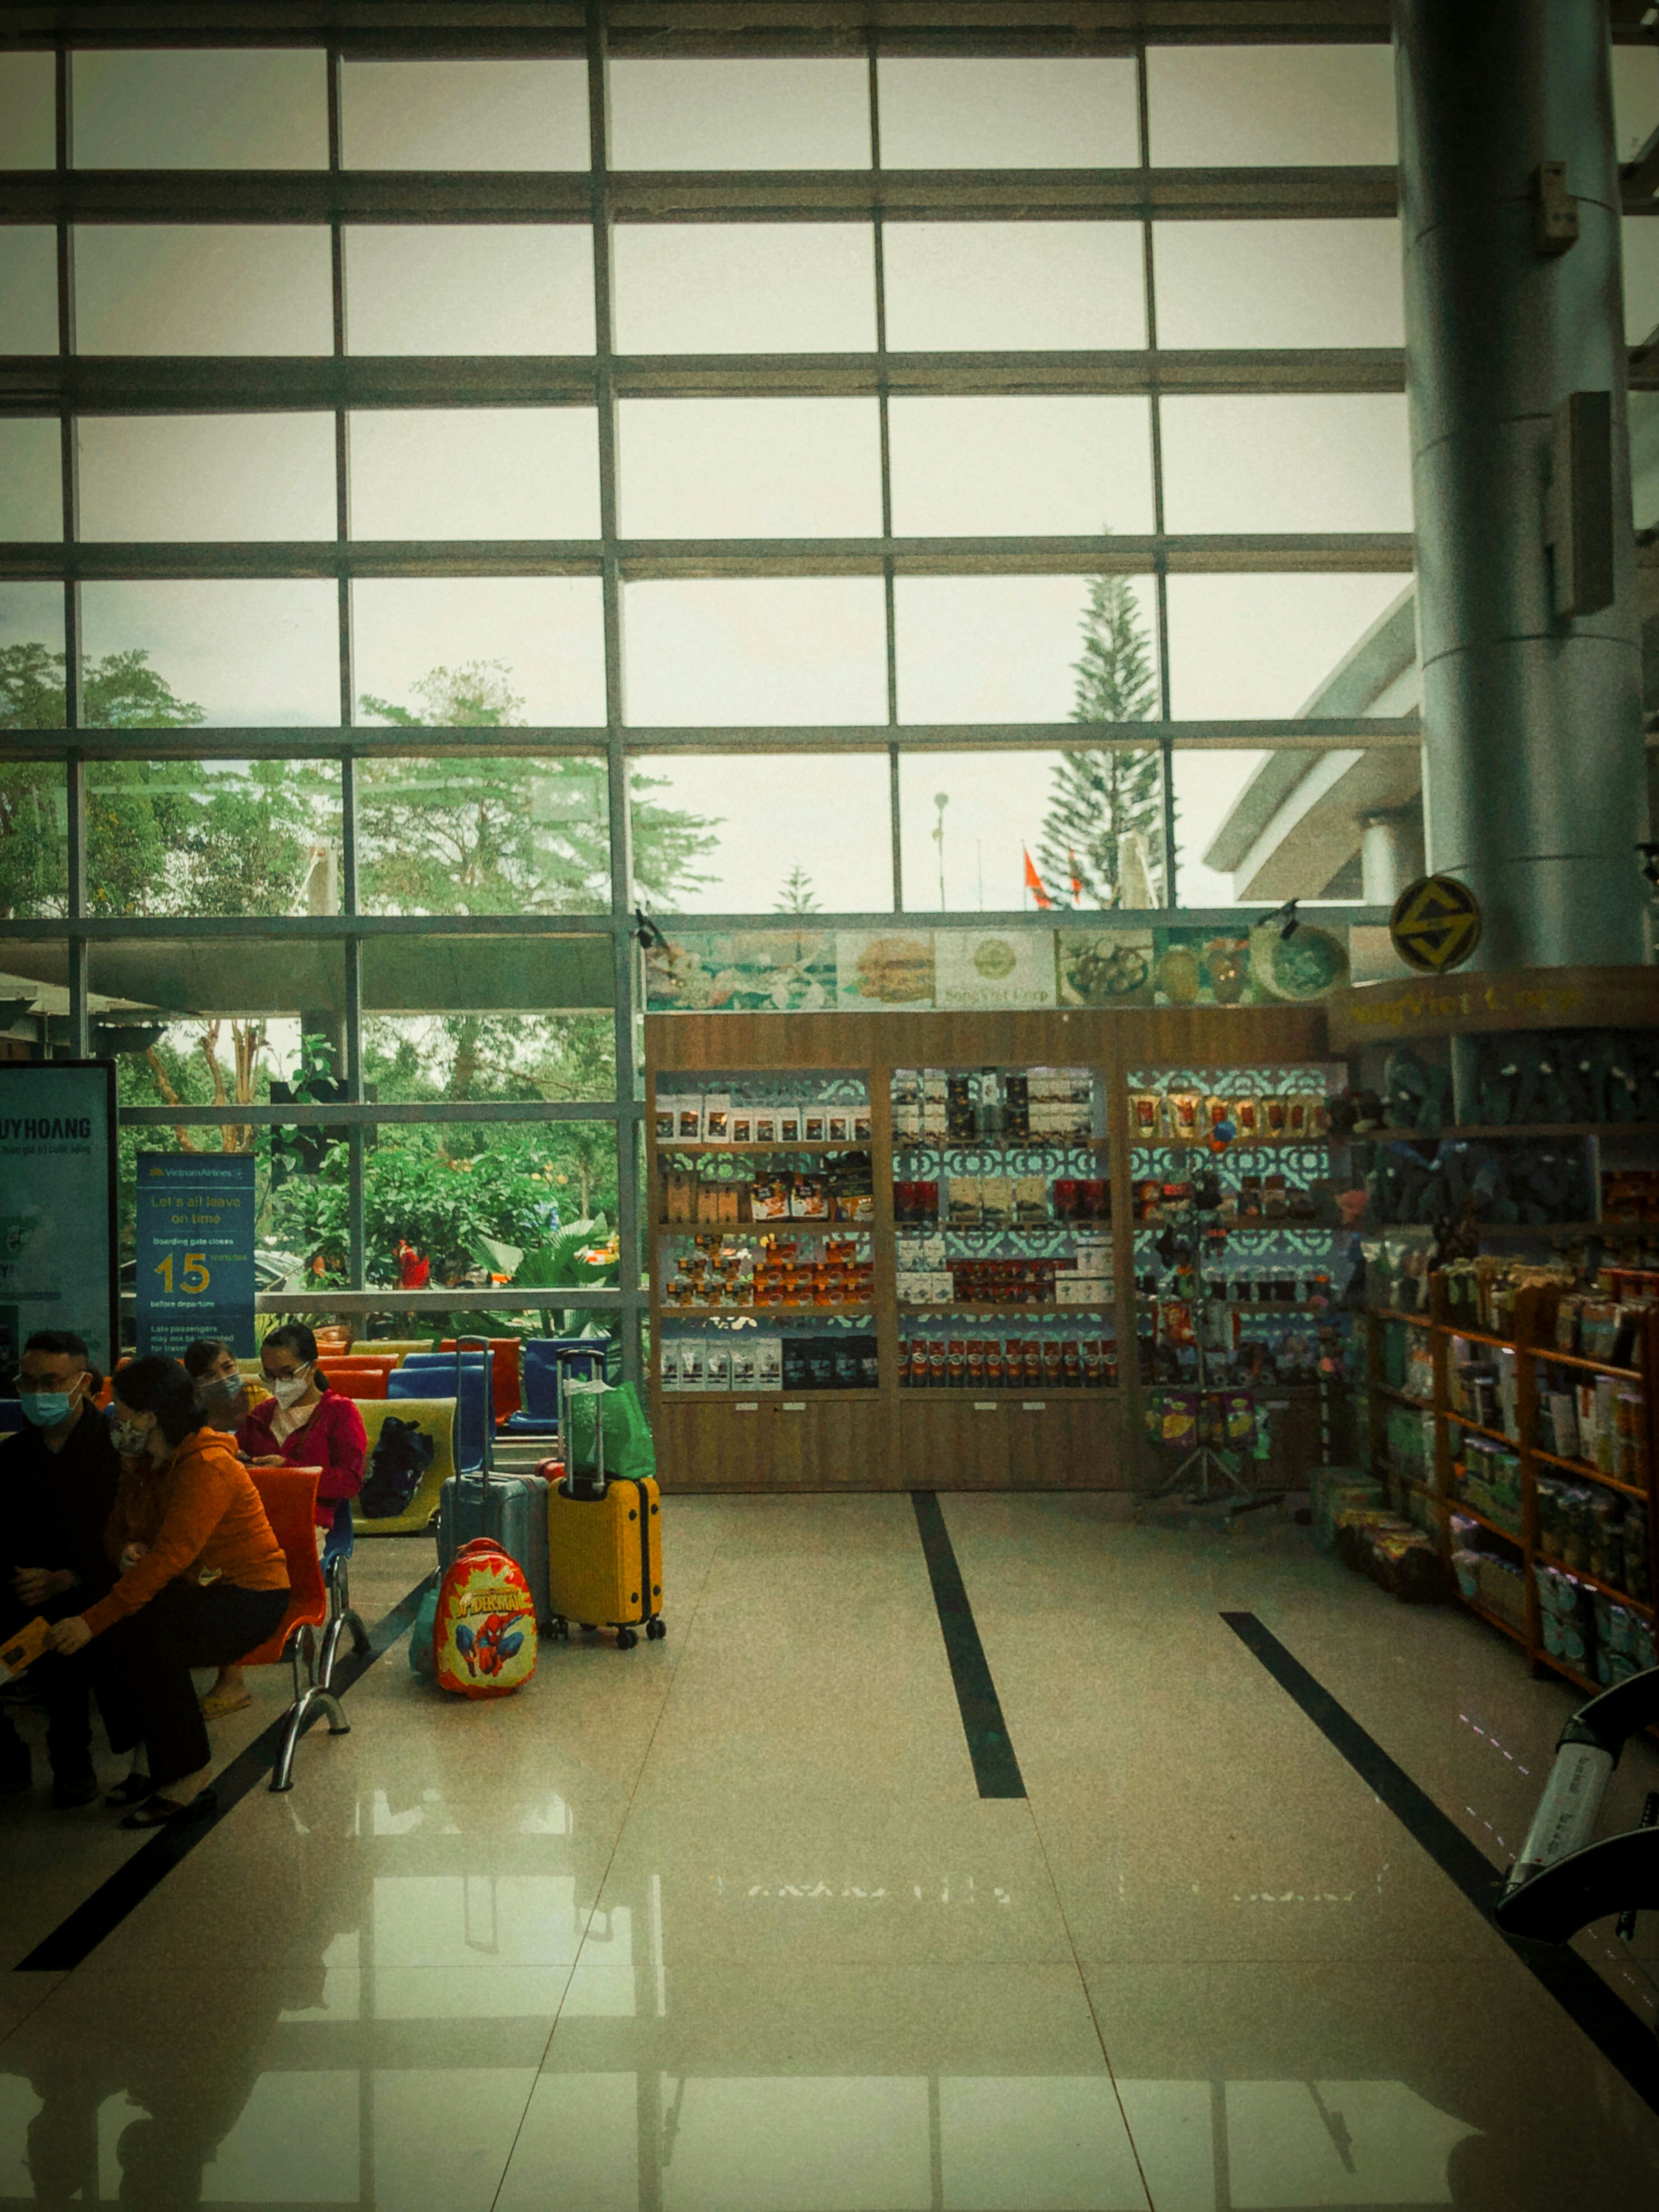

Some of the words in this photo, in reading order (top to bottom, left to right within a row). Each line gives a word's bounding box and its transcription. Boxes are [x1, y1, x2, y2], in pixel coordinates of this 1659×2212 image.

[151, 1196, 183, 1207] Let's
[187, 1196, 202, 1207] all
[206, 1196, 240, 1207] leave
[172, 1215, 188, 1224] on
[192, 1213, 221, 1224] time
[153, 1238, 188, 1246] Boarding
[154, 1253, 210, 1294] 15
